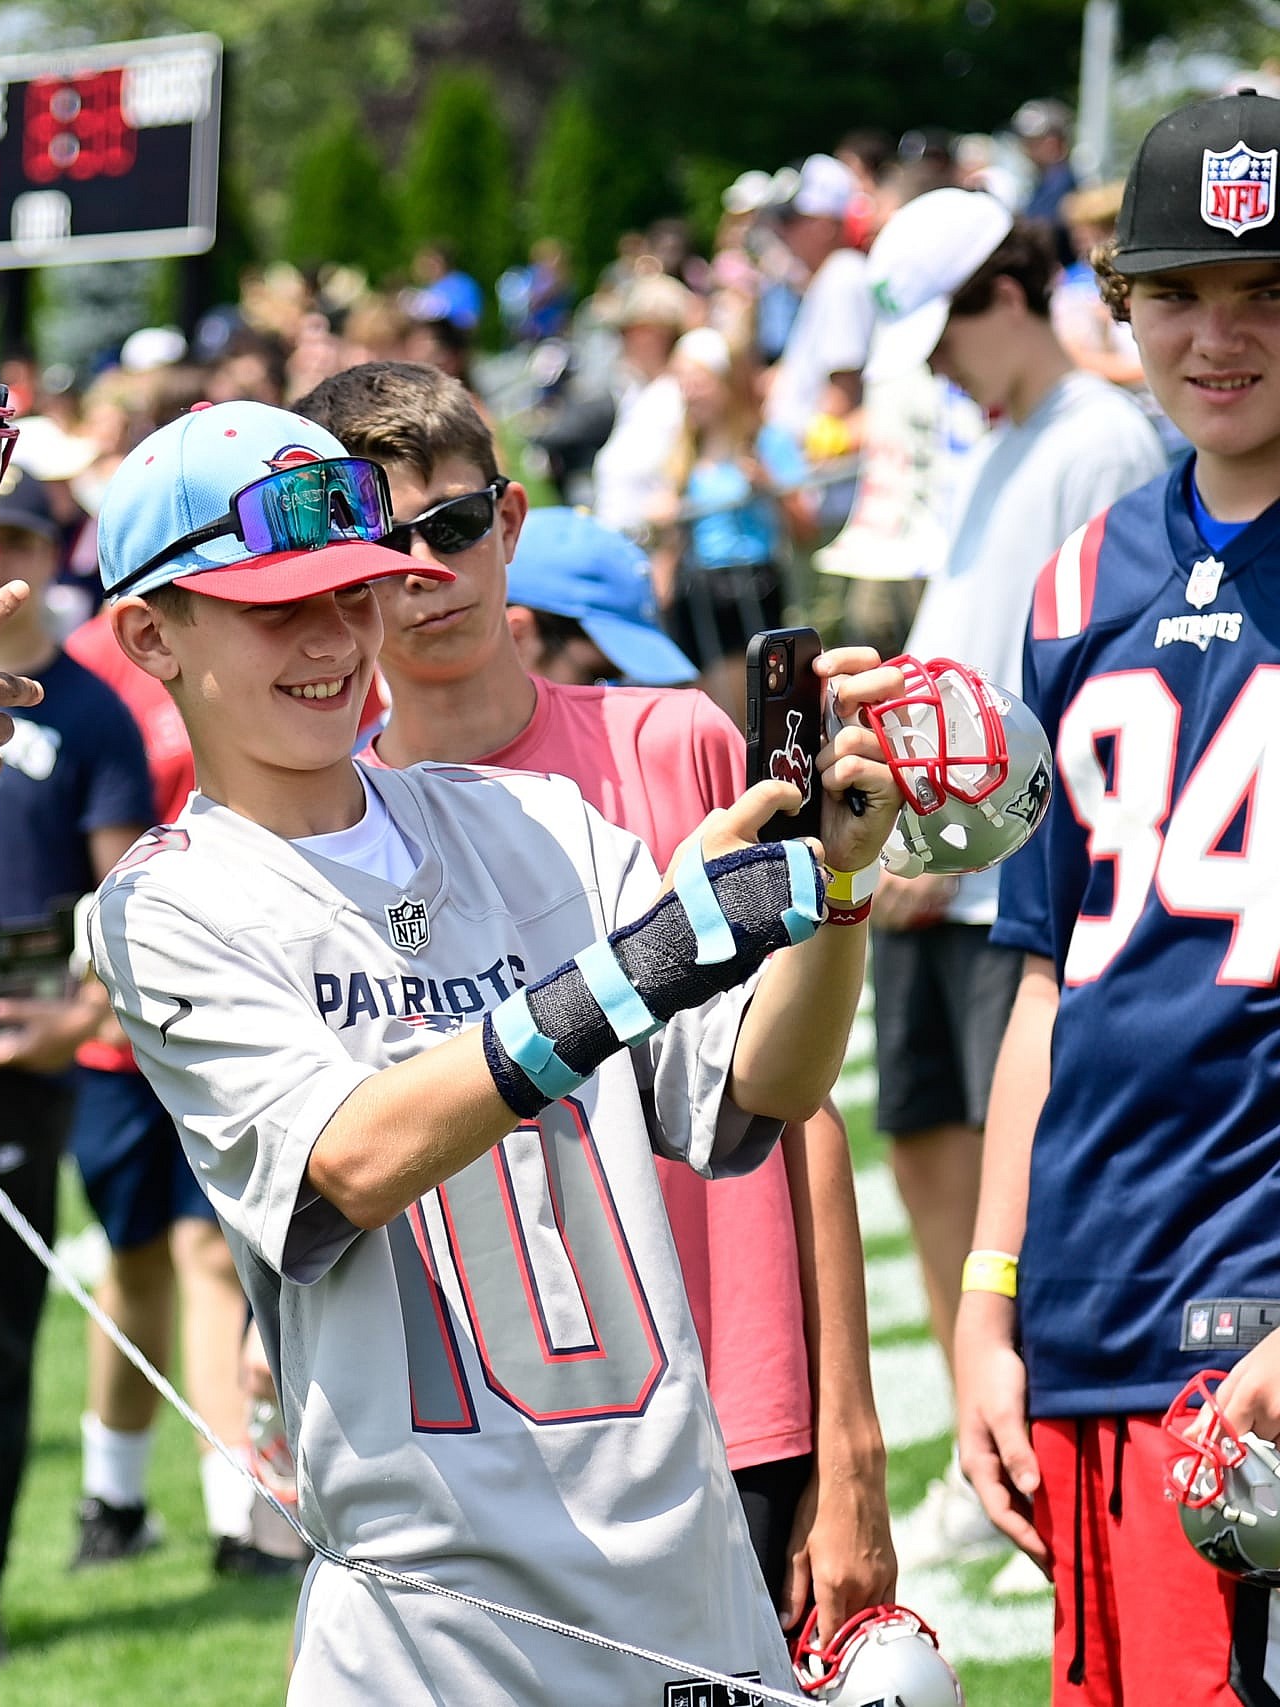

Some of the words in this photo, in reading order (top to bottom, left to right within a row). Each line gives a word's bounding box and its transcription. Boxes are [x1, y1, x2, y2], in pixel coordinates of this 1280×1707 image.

[1210, 185, 1267, 223] NFL
[395, 919, 426, 945] NFL
[384, 1093, 670, 1435] 10
